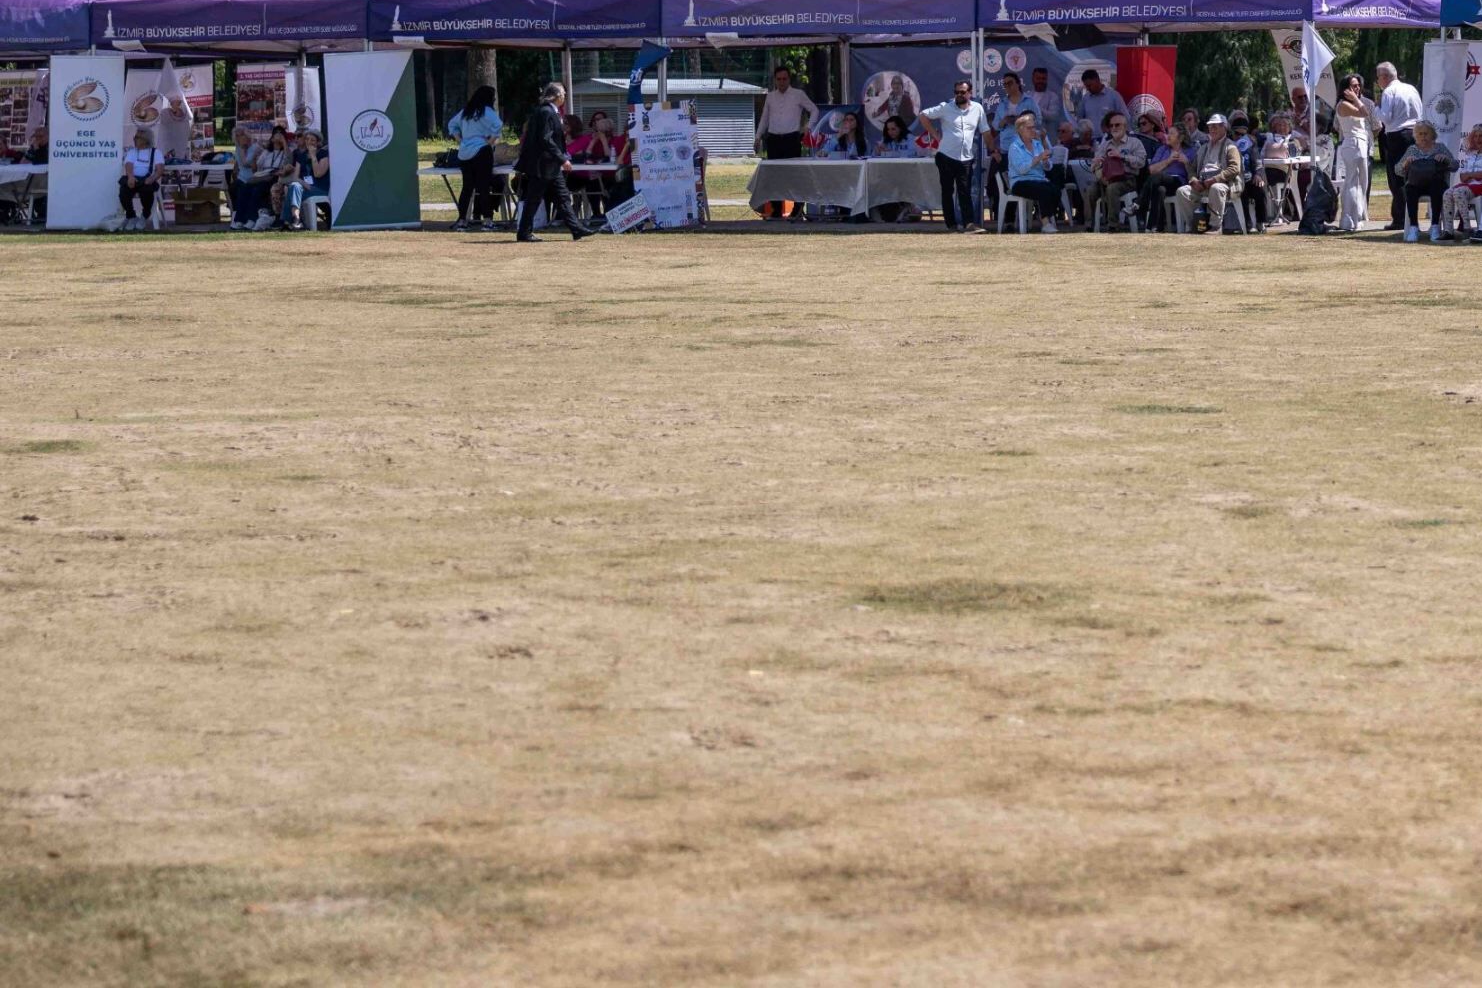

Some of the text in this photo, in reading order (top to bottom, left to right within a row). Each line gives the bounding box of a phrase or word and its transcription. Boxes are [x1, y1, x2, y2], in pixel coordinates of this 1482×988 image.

[699, 16, 729, 27] İZMİR
[797, 12, 854, 24] BELEDİYESİ
[1012, 9, 1045, 21] İZMİR
[1122, 5, 1186, 17] BELEDİYESİ
[117, 27, 144, 38] İZMİR
[207, 23, 261, 36] BELEDİYESİ
[403, 21, 431, 31] İZMİR
[495, 18, 550, 30] BELEDİYESİ
[56, 139, 116, 149] ÜÇÜNCÜ YAŞ
[53, 150, 118, 159] ÜNİVERSİTESİ
